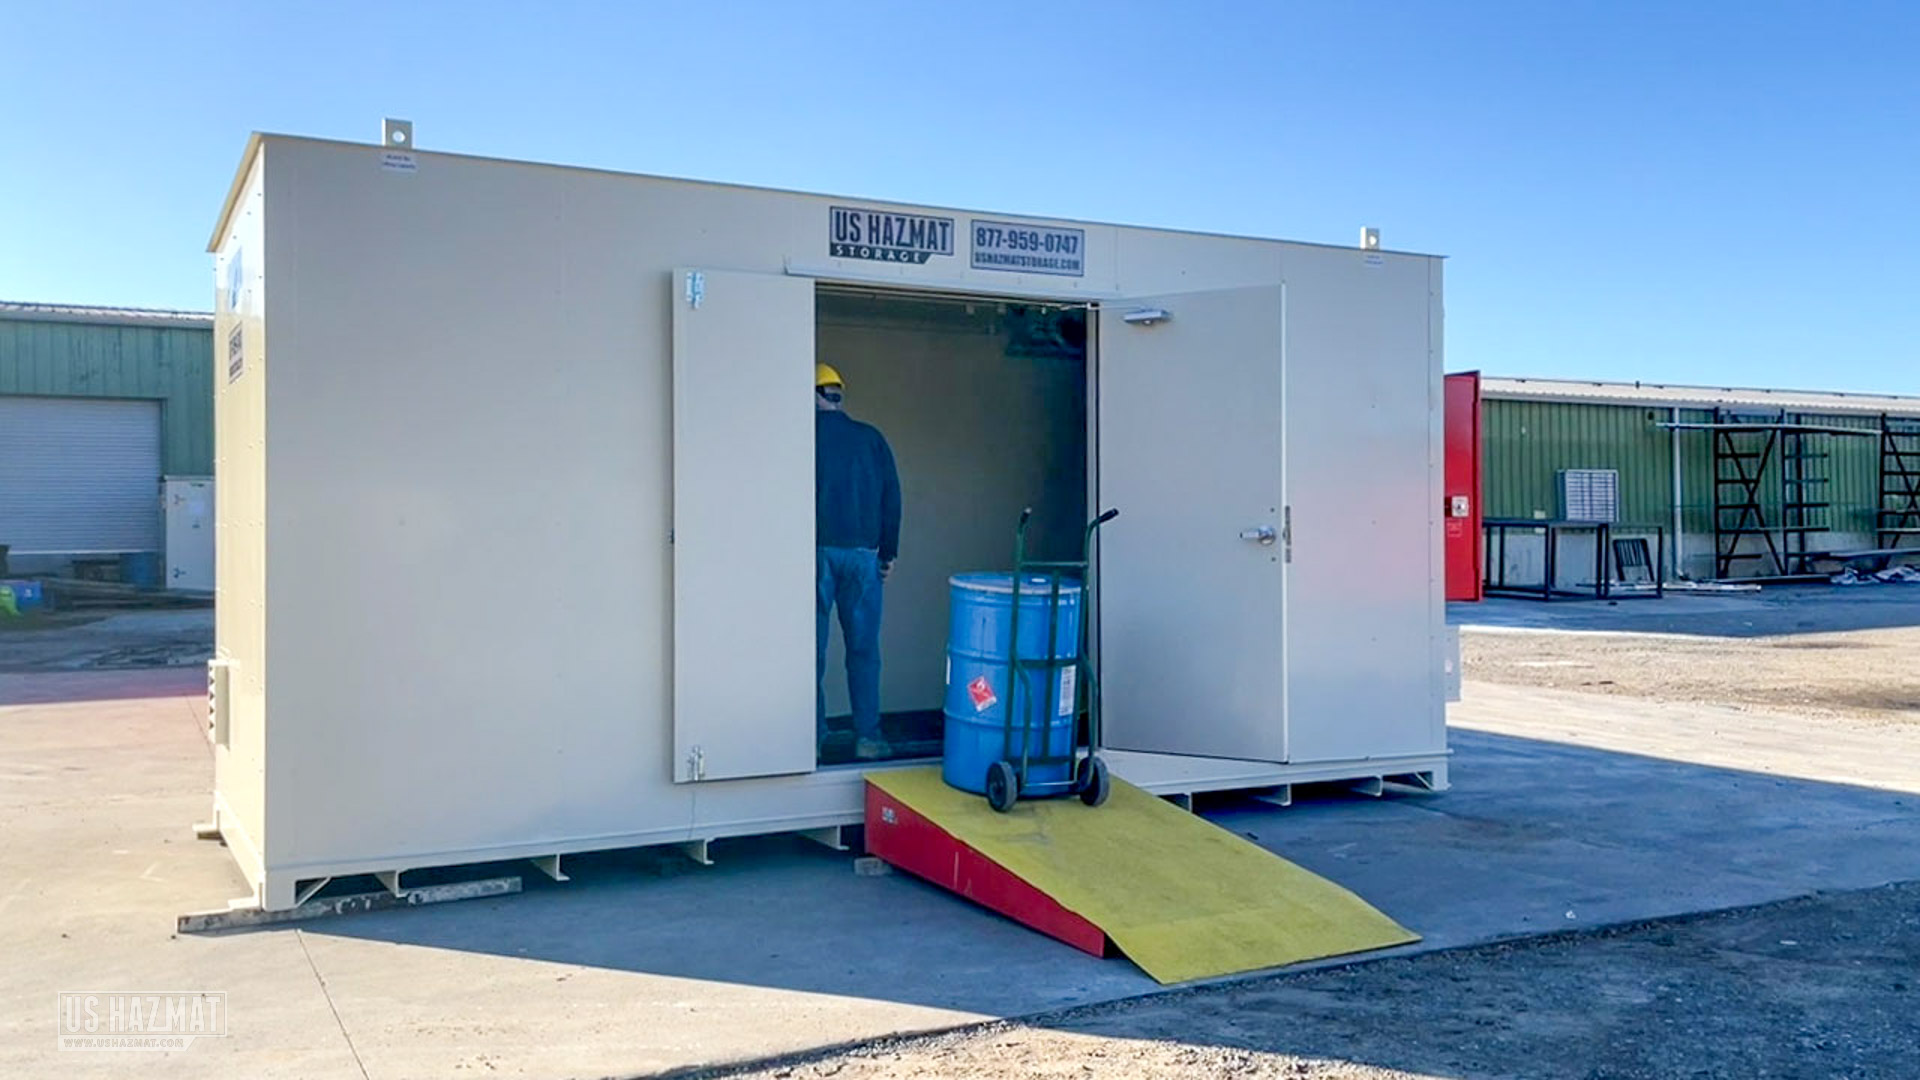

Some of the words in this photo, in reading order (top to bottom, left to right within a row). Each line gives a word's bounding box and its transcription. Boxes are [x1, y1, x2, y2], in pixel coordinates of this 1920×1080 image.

[835, 211, 861, 242] US
[868, 215, 950, 251] HAZMAT
[976, 227, 1078, 254] 877-959-0747
[836, 245, 921, 263] STORAGE
[974, 252, 1080, 271] USHAZMATSTORAGE.COM
